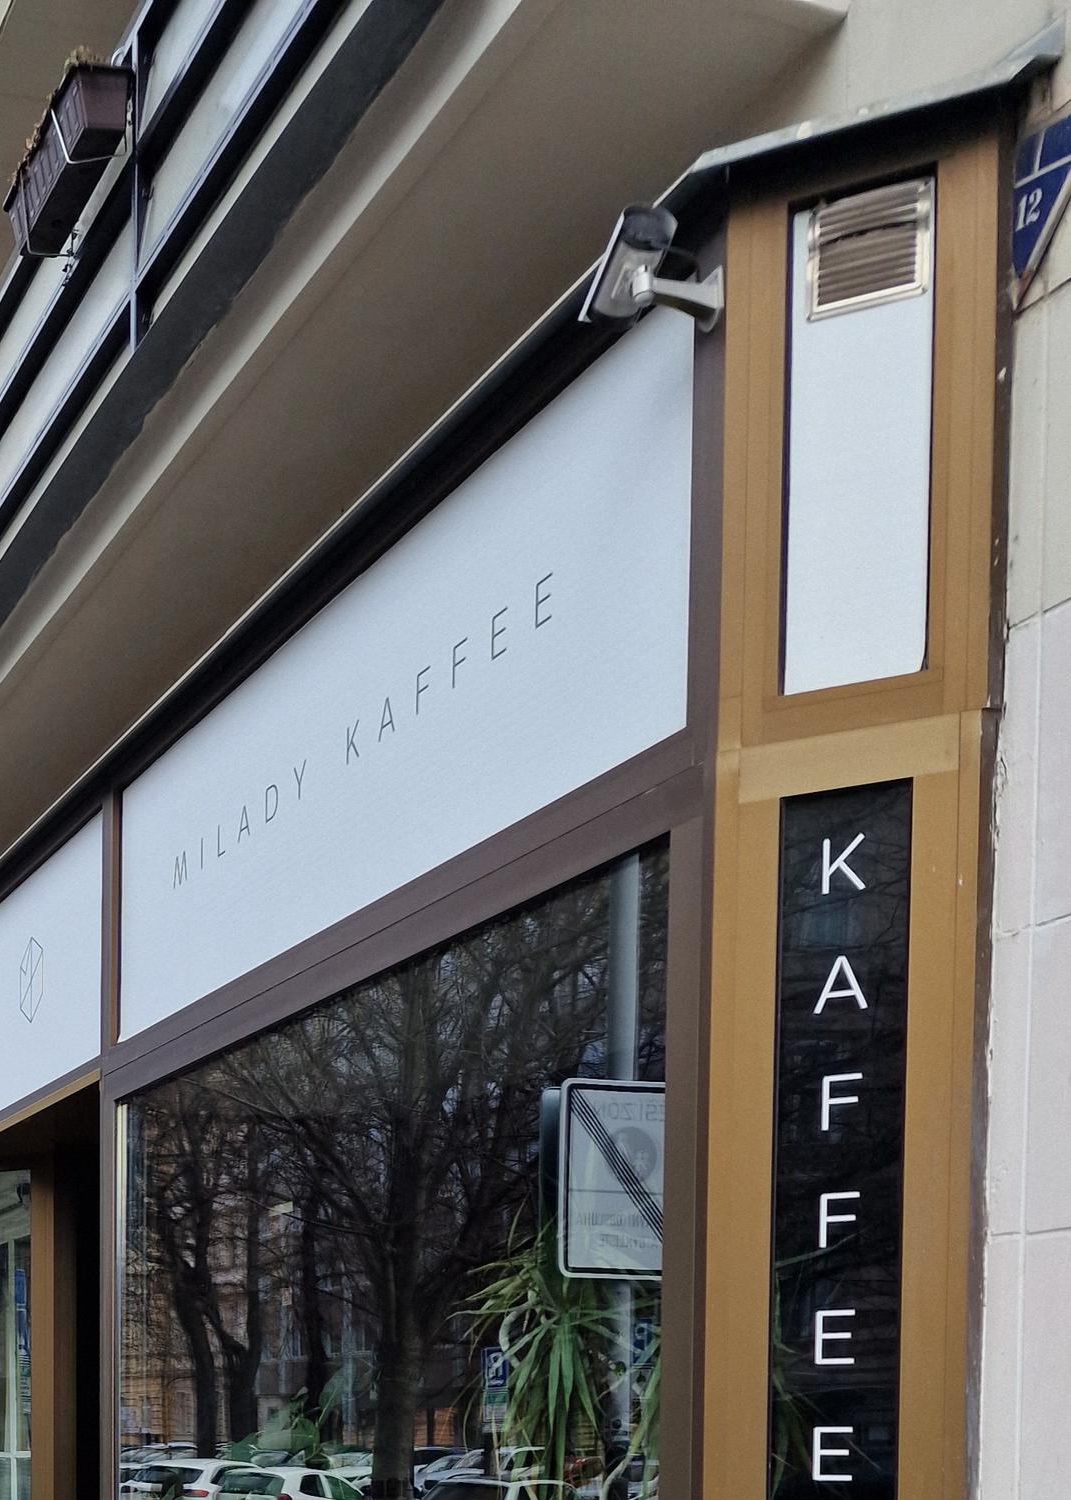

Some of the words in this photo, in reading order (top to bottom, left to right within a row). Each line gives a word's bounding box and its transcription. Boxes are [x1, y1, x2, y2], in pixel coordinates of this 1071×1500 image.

[1014, 187, 1043, 233] 12
[172, 758, 307, 889] MILADY
[345, 571, 554, 765] KAFFEE
[811, 832, 869, 1482] KAFFEE
